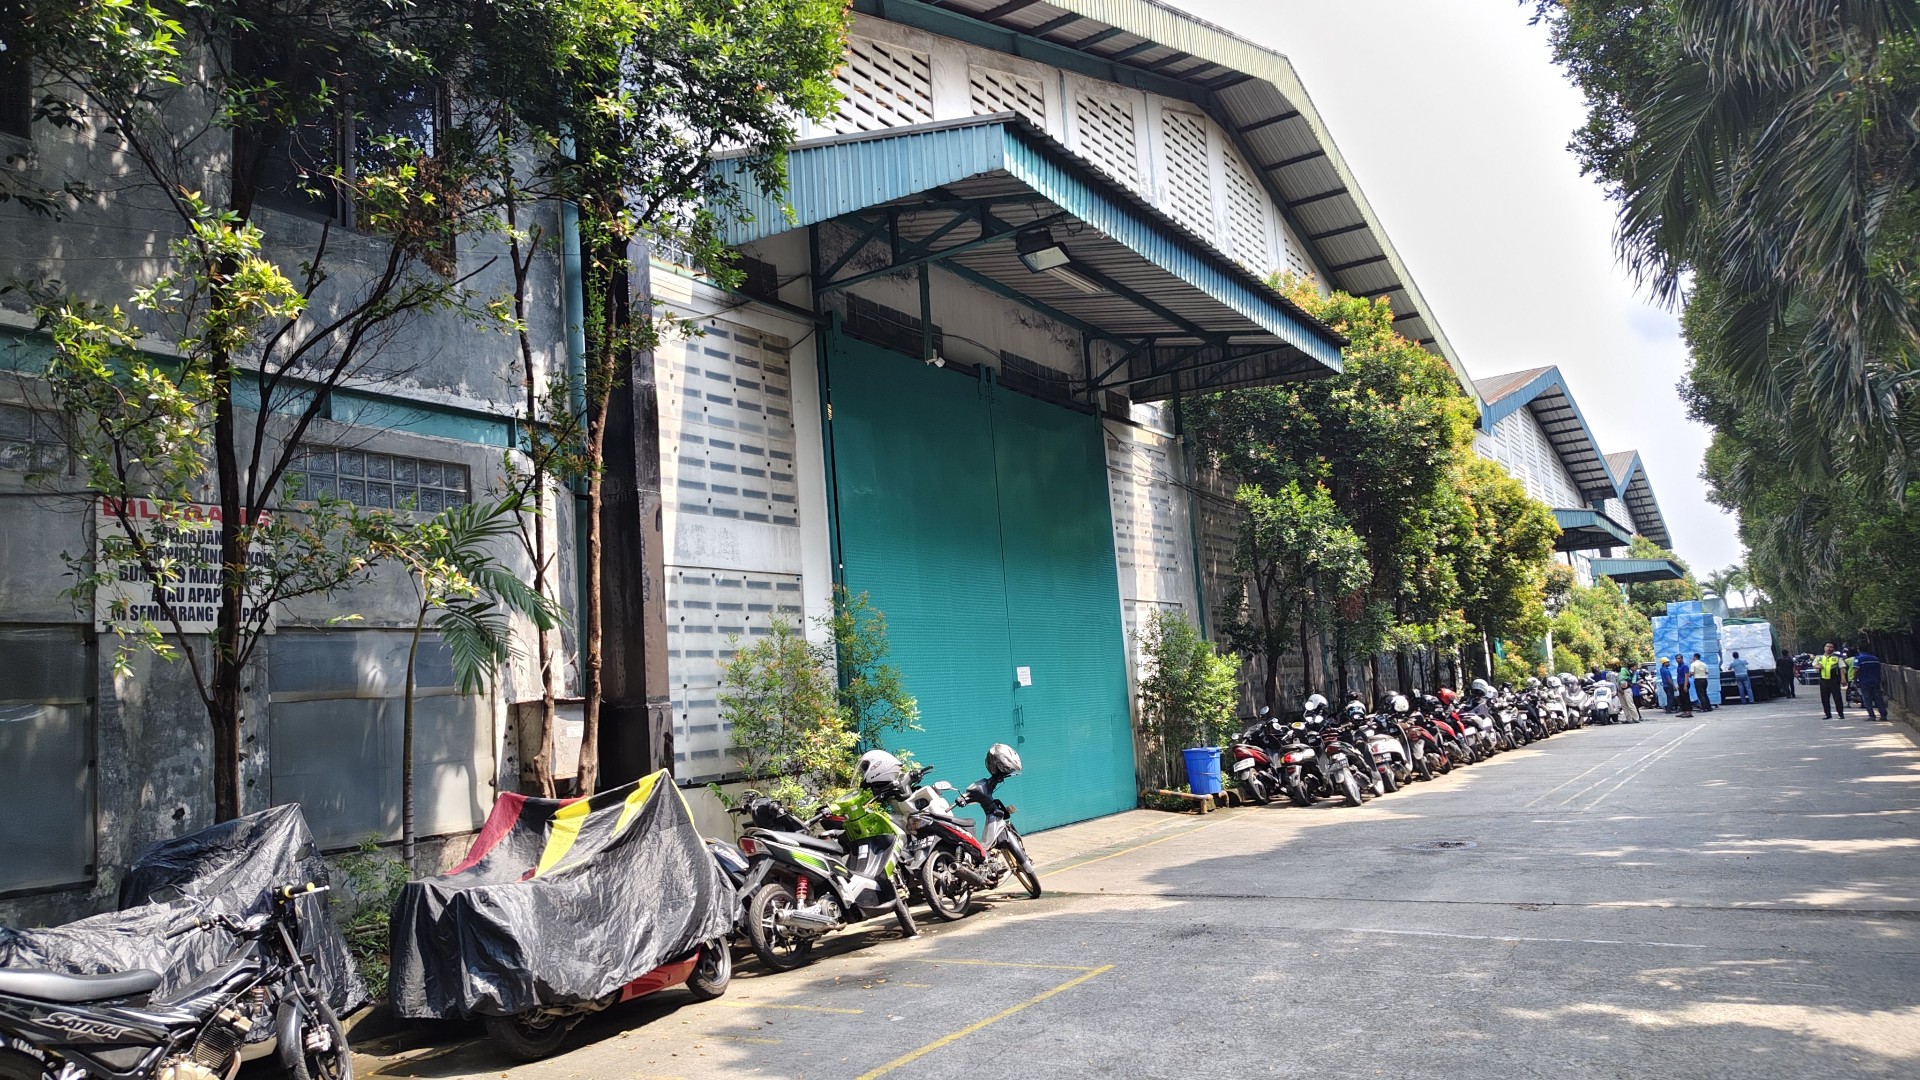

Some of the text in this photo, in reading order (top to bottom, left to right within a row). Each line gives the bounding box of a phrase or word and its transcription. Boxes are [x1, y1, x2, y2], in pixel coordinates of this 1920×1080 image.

[103, 498, 272, 527] DILRA
[157, 527, 224, 546] EMBUAN
[119, 565, 186, 584] BUNUS
[152, 586, 224, 604] AAU APAP
[130, 605, 214, 622] SEMBARANG
[38, 1011, 132, 1039] SATRIA
